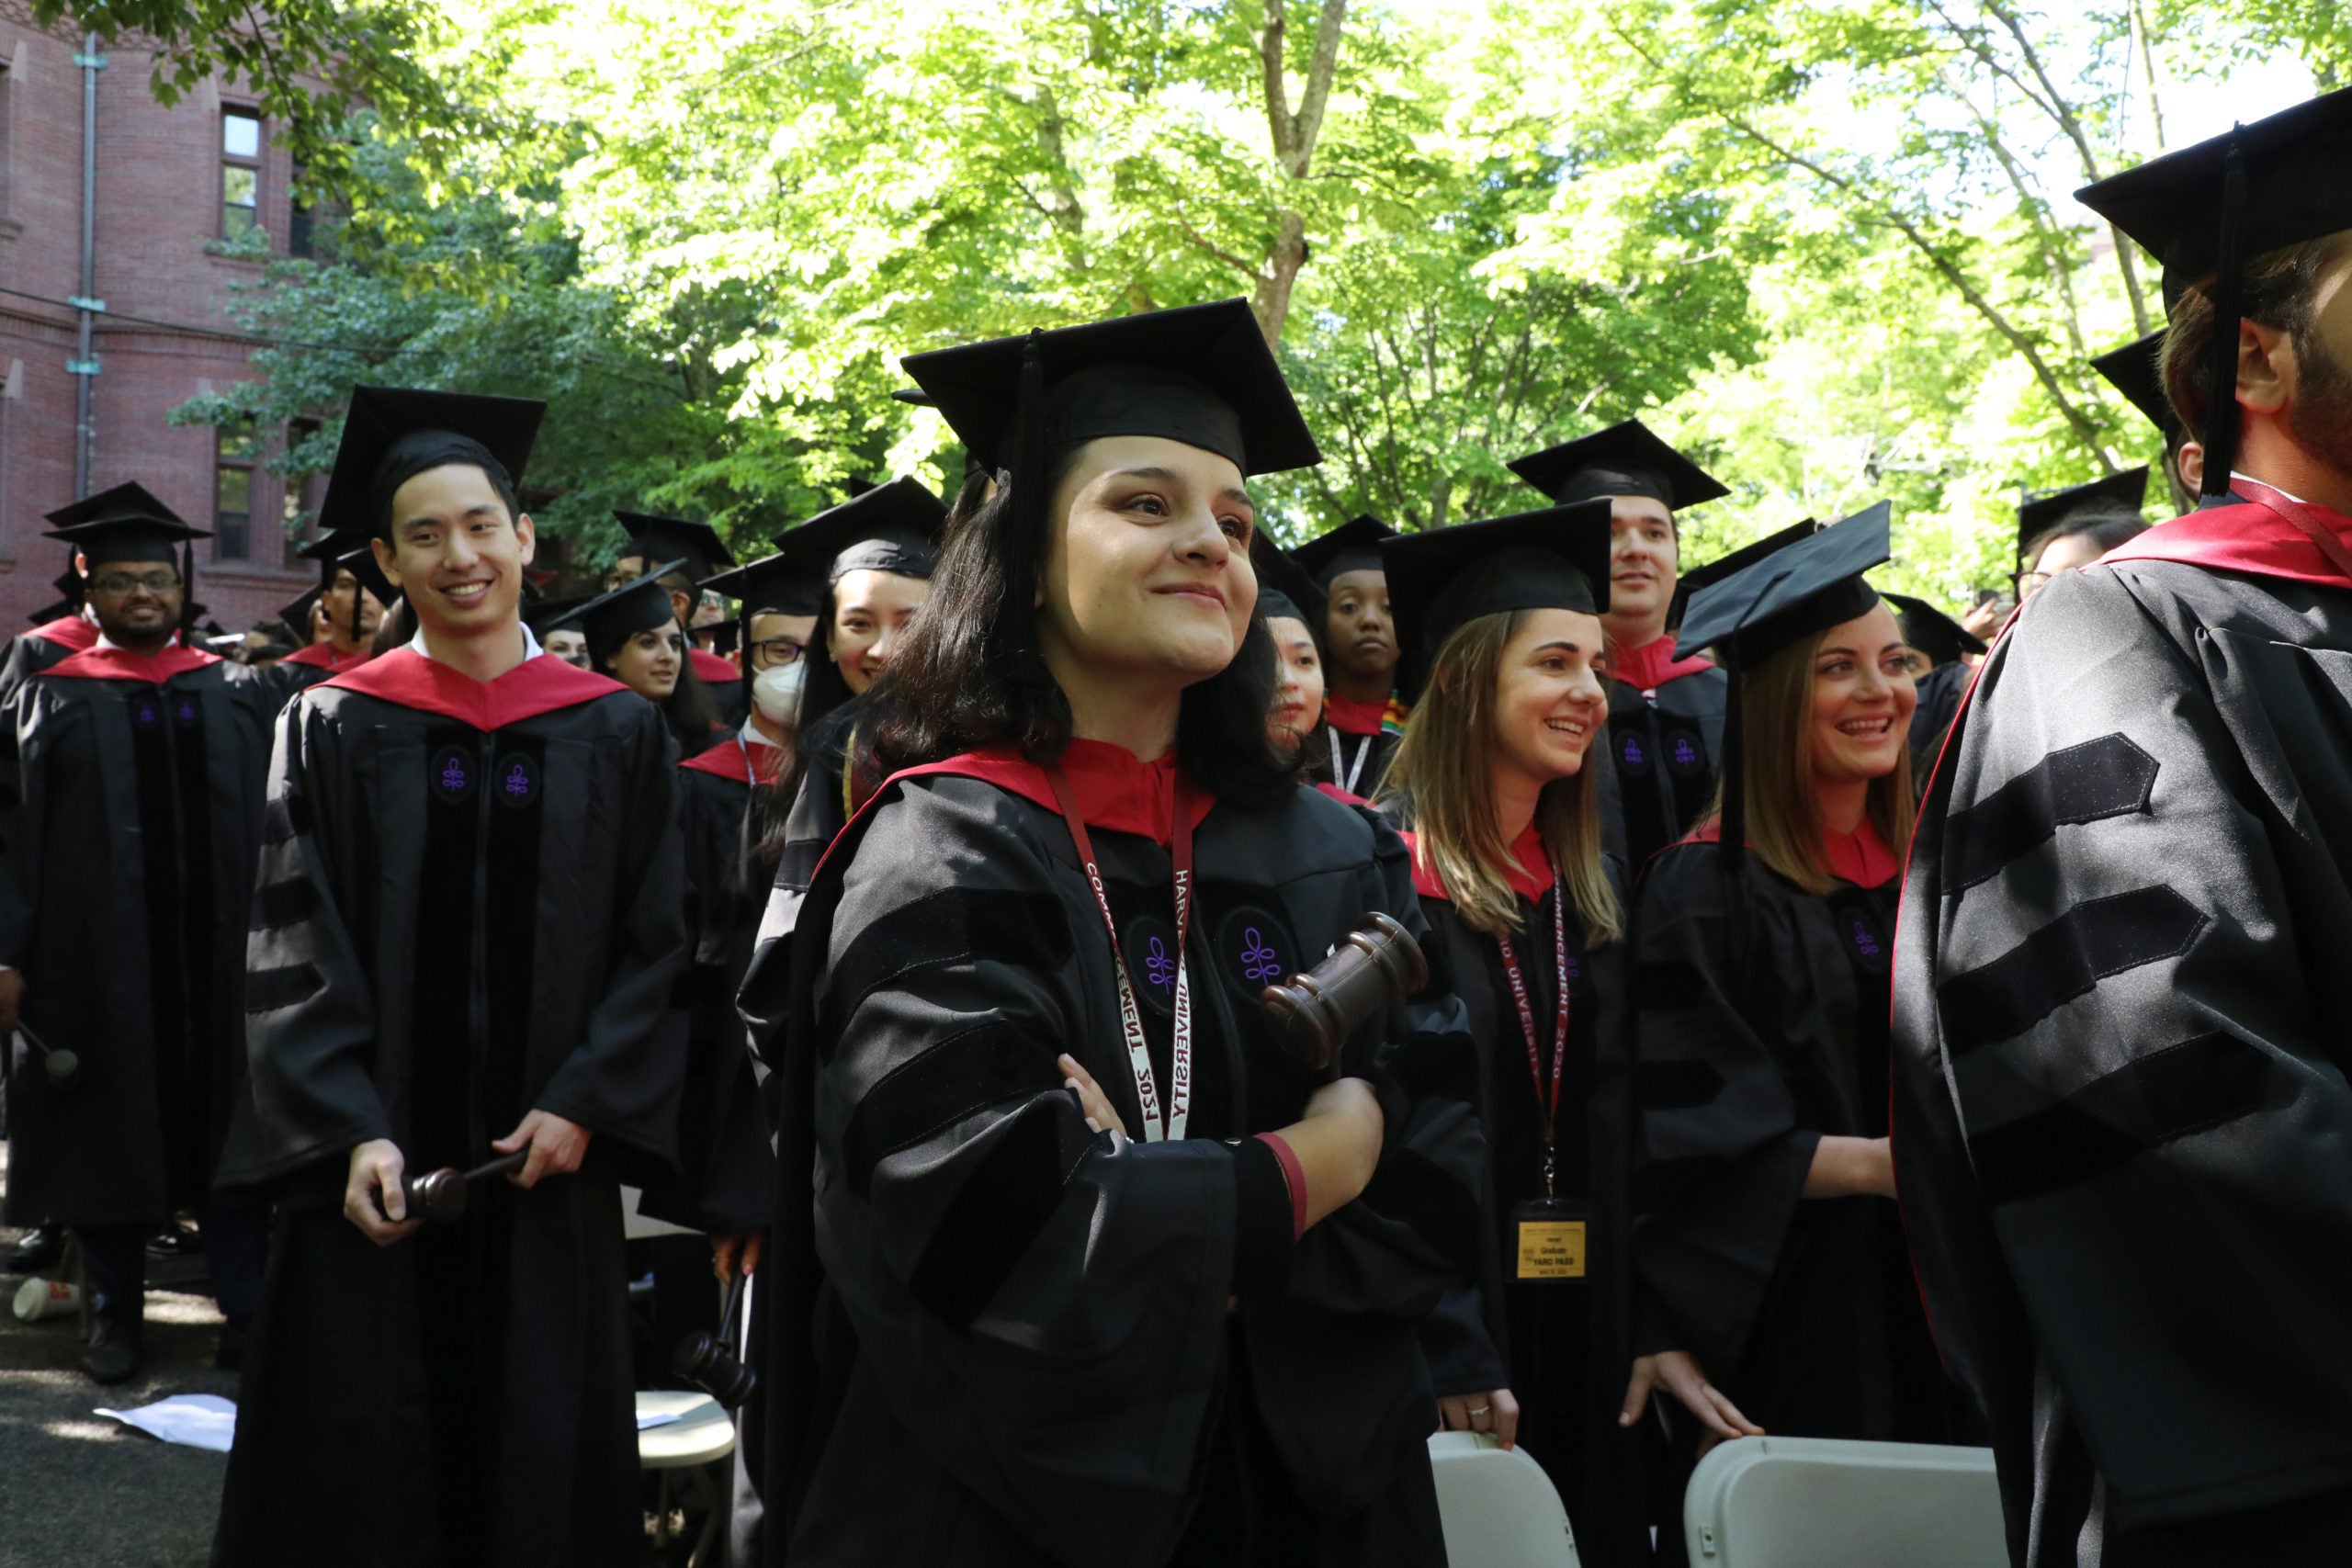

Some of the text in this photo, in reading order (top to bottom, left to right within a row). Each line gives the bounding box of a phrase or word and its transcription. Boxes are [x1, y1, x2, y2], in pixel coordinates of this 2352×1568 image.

[1509, 967, 1541, 1077] UNIVERSITY
[1533, 1258, 1574, 1266] YARD PASS
